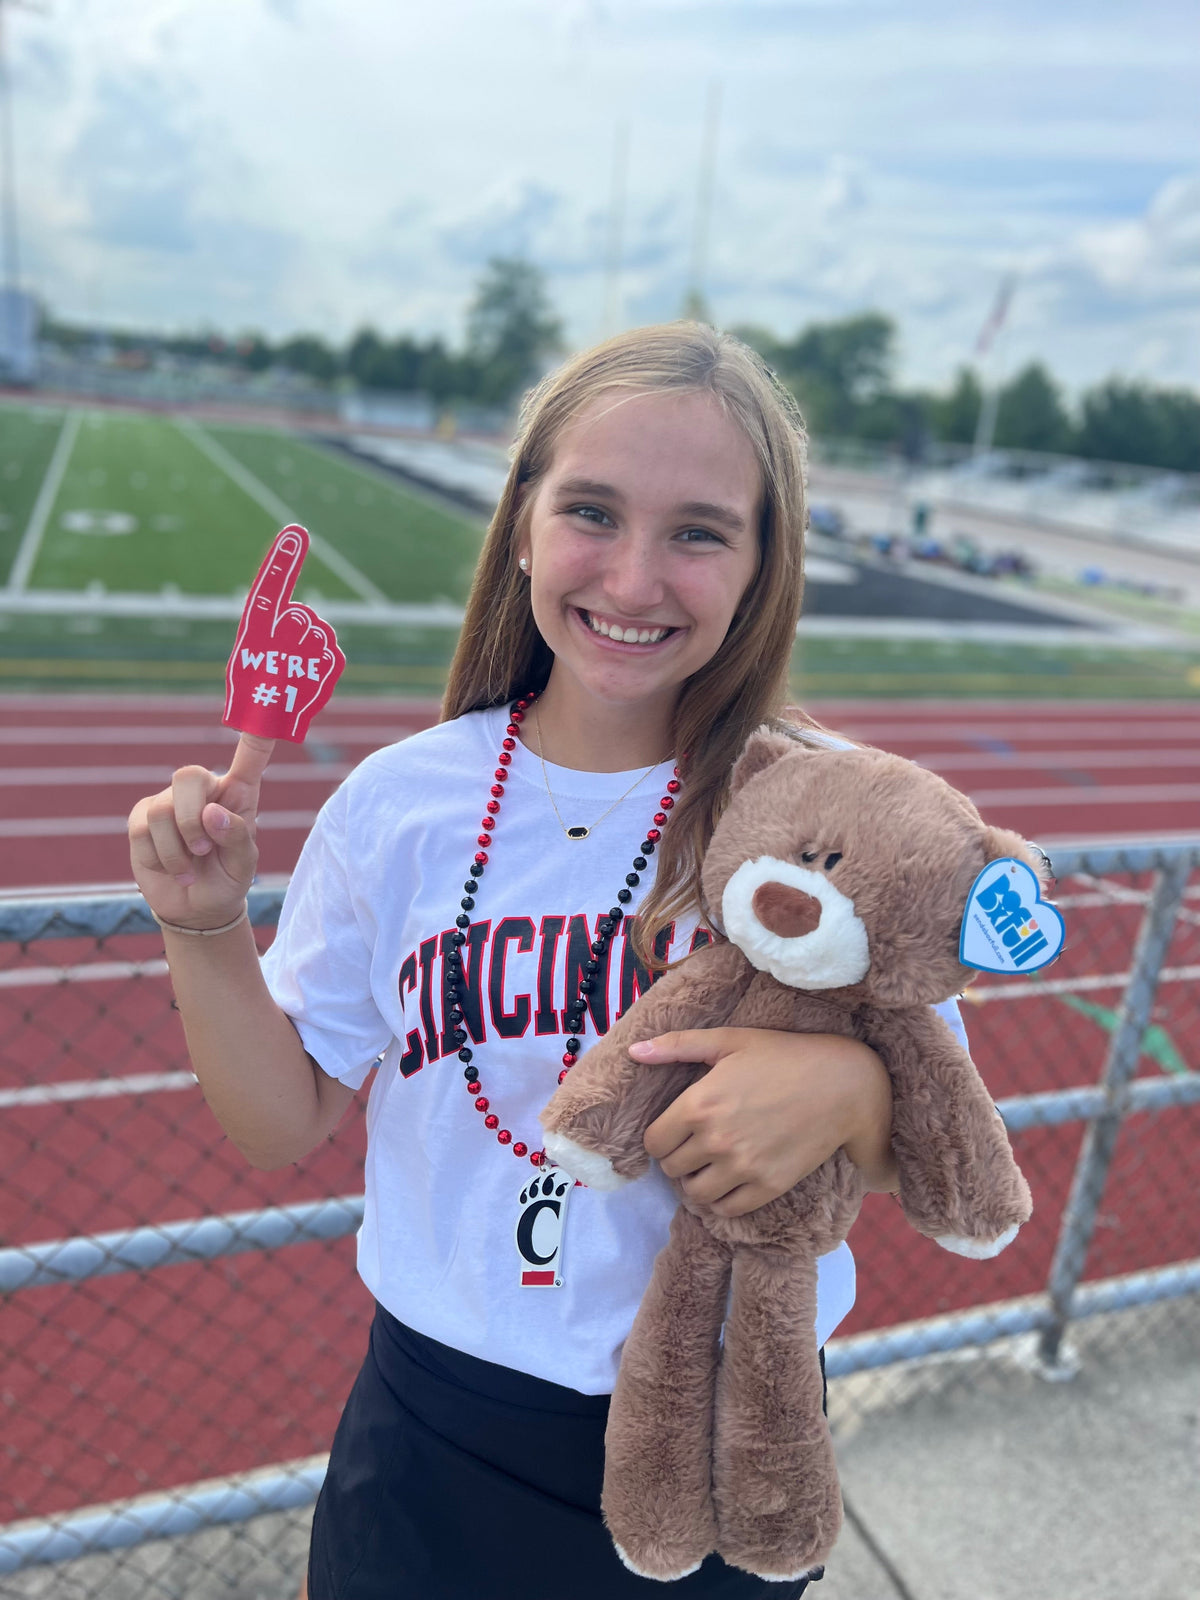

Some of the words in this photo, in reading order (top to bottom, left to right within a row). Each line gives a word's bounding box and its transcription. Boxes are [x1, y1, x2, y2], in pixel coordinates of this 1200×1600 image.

[241, 648, 320, 682] WE'RE
[252, 683, 298, 713] #1
[399, 914, 714, 1079] CINCINN
